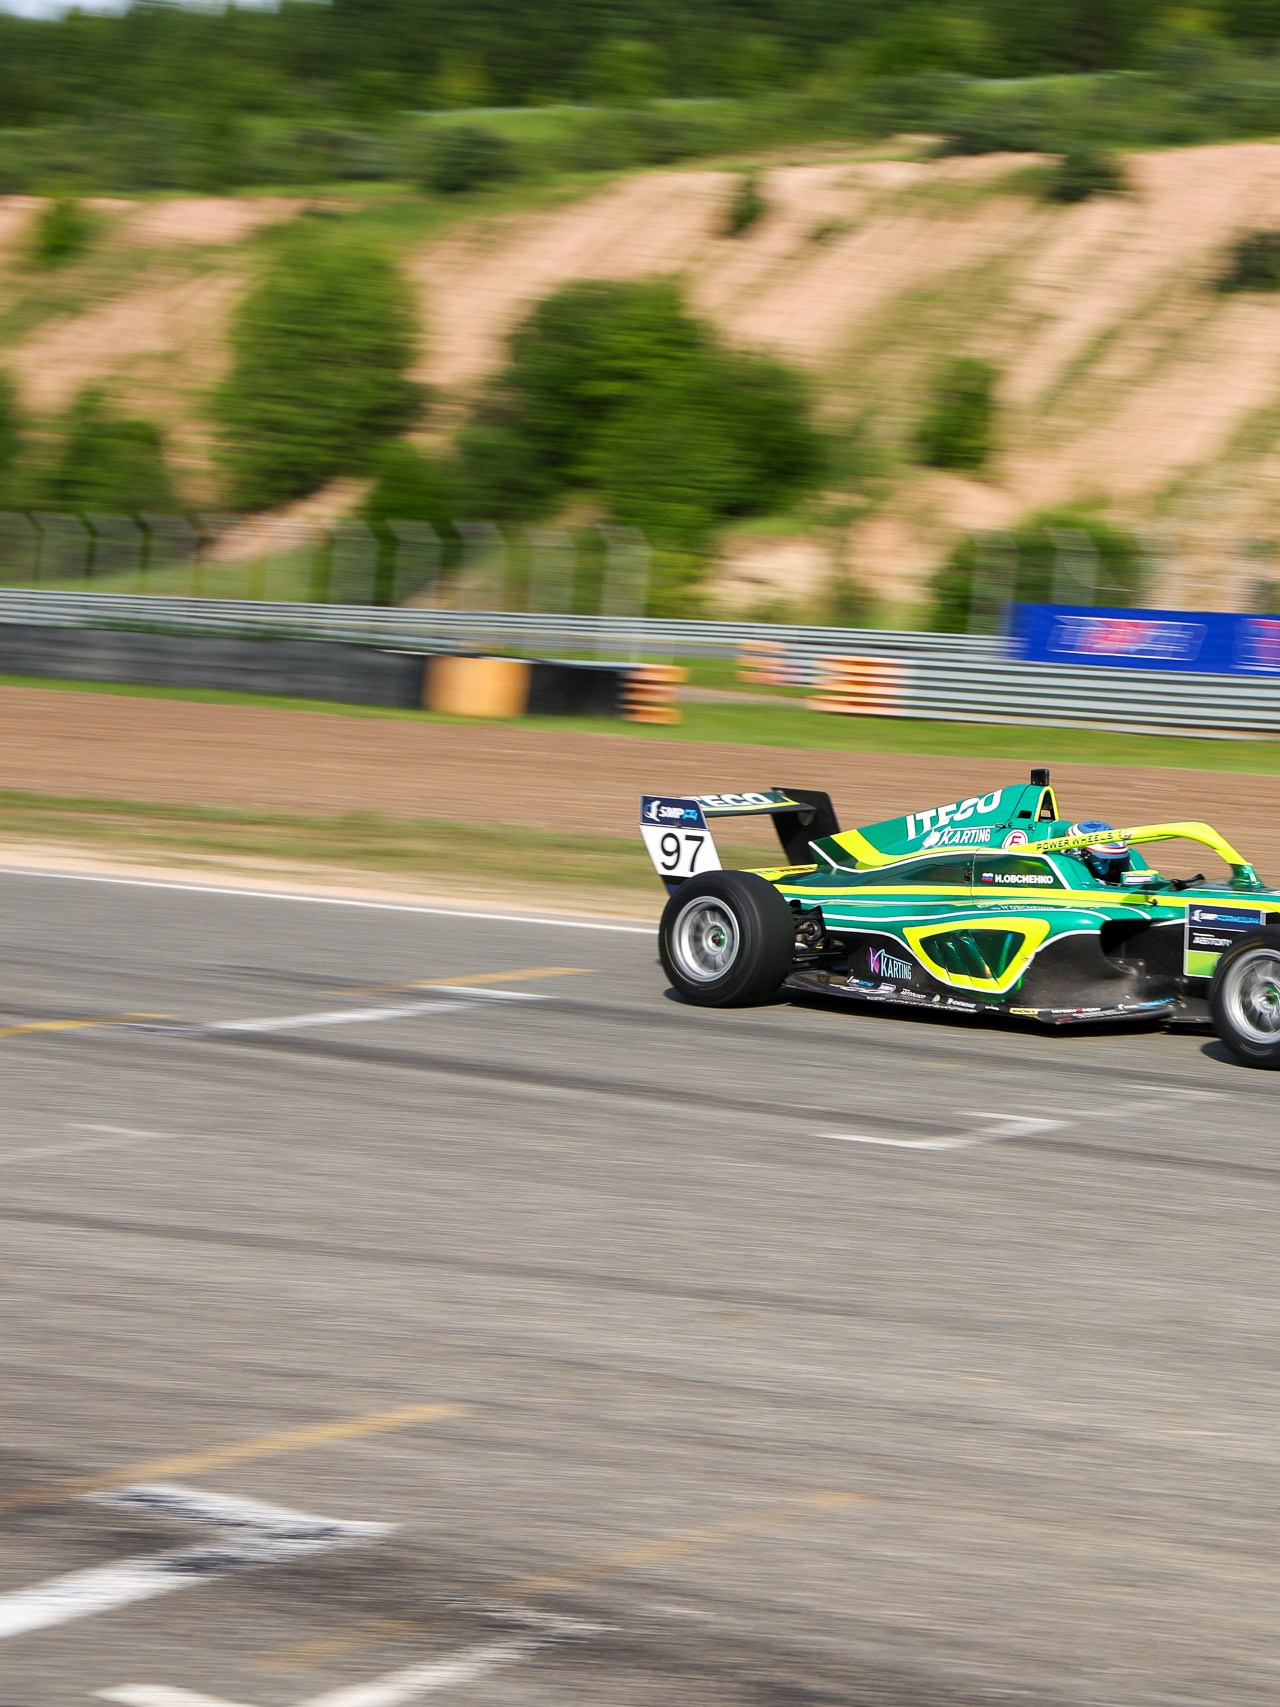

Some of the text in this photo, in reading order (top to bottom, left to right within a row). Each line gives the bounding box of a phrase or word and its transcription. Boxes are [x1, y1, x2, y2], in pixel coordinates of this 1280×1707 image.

[906, 789, 1003, 841] ITECO
[938, 828, 991, 845] KARTING
[1037, 838, 1069, 851] POWER
[1072, 832, 1114, 846] WHEELS
[660, 832, 705, 873] 97
[994, 874, 1054, 884] И.ОВСИЕНКО
[881, 952, 912, 980] KARTING
